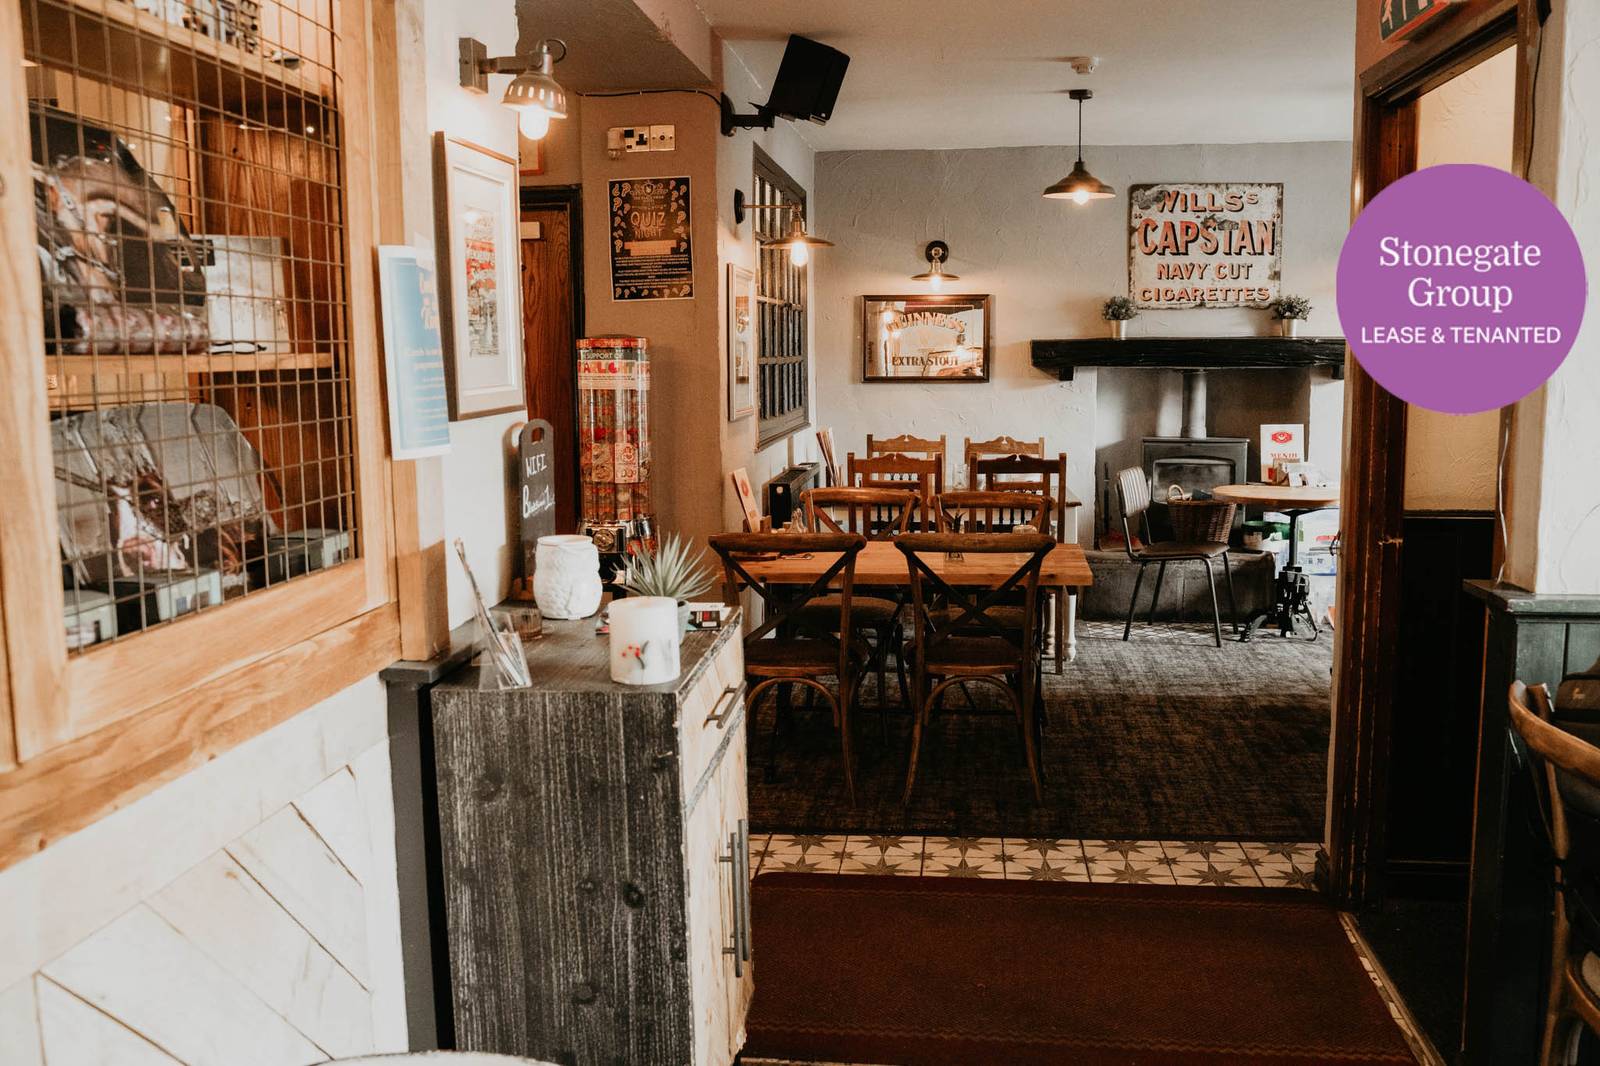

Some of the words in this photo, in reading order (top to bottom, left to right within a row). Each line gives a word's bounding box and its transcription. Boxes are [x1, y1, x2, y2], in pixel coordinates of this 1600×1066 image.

[630, 211, 666, 227] QUIZ
[634, 227, 664, 239] NIGHT
[1156, 262, 1209, 280] NAVY
[1215, 262, 1253, 280] CUT
[1140, 287, 1271, 302] CIGARETTES
[891, 355, 927, 367] EXTRA
[928, 355, 959, 367] STOUT
[525, 453, 548, 478] WIFI
